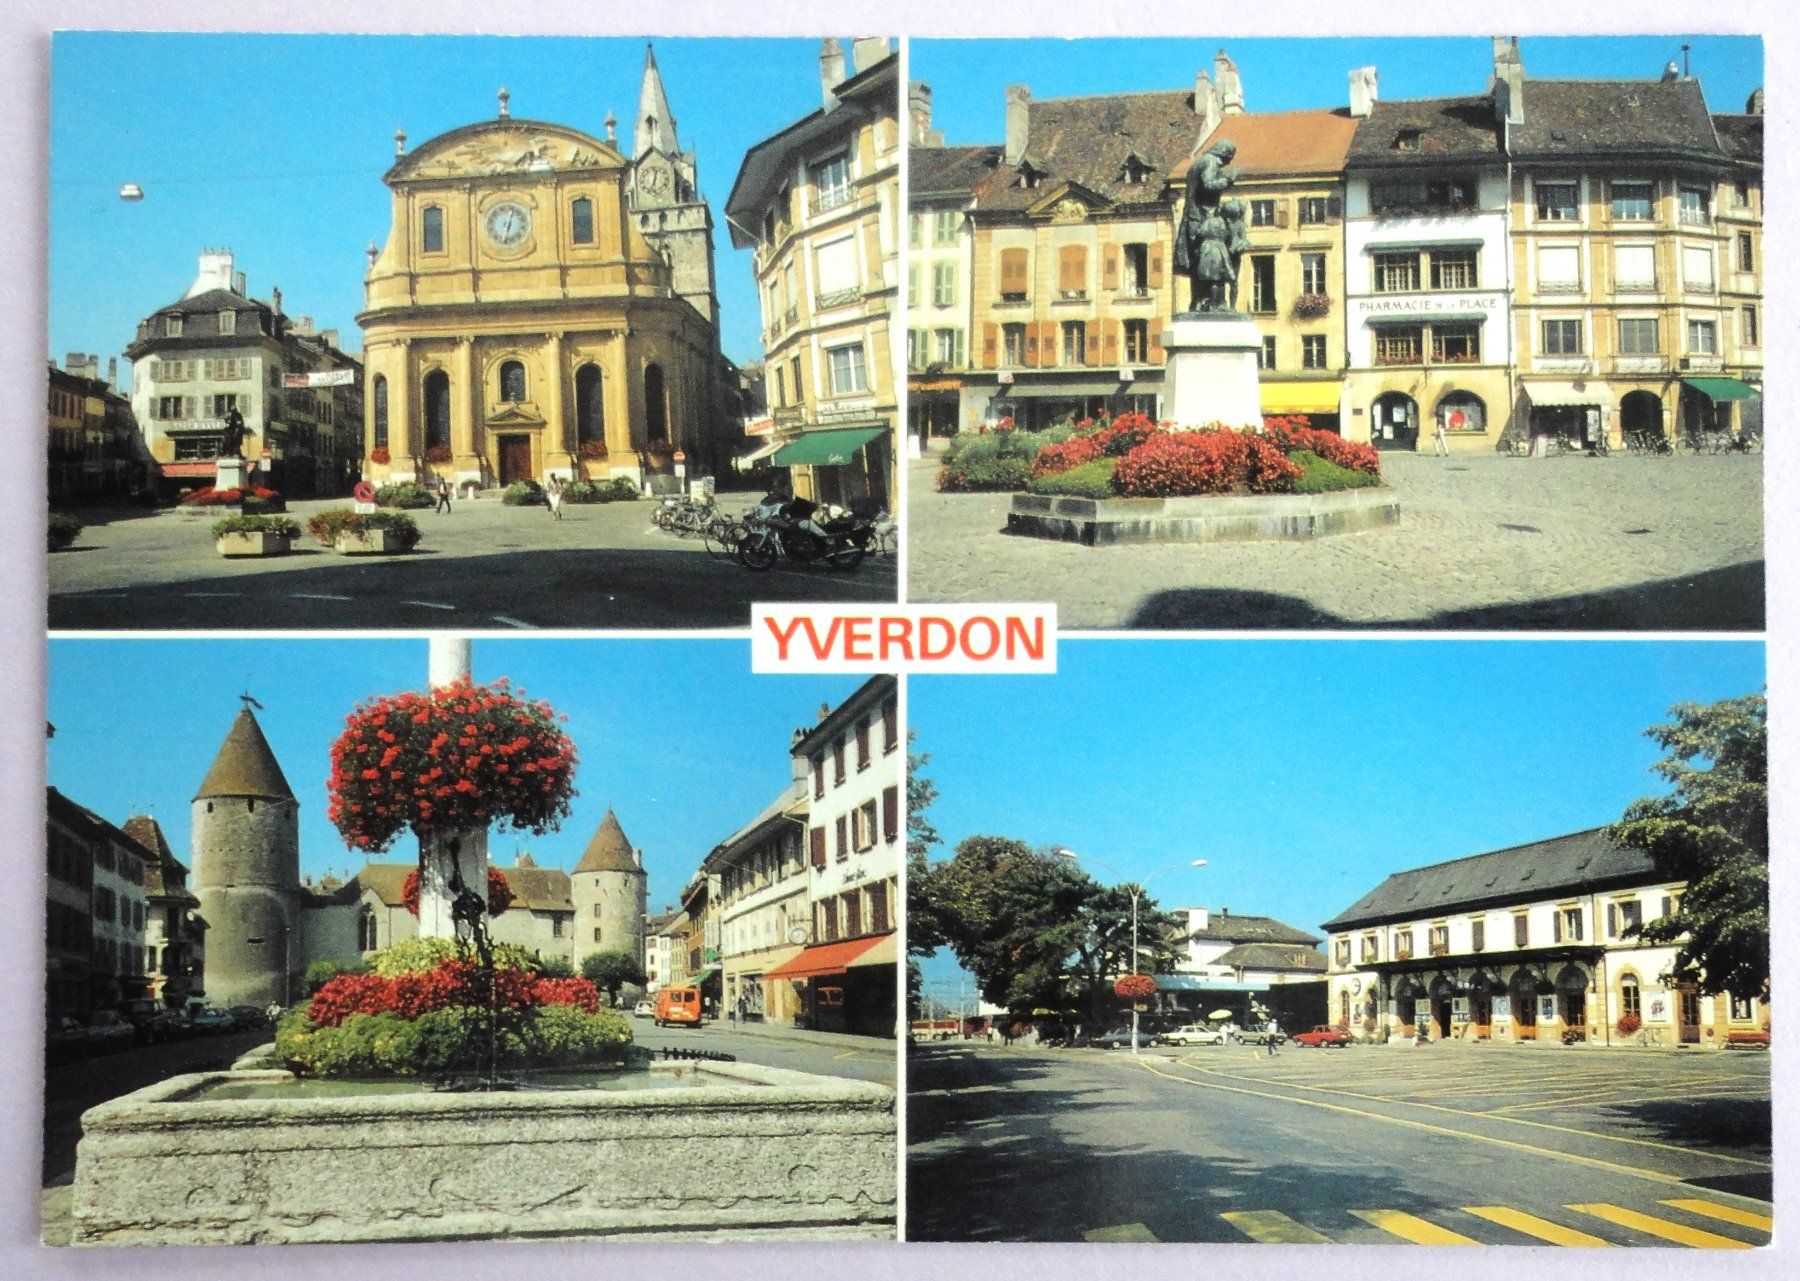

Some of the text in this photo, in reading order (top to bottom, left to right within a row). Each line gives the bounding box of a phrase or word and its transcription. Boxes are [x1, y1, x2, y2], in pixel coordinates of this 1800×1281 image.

[1359, 300, 1431, 312] PHARMACIE
[1459, 298, 1497, 309] PLACE
[763, 616, 1044, 661] YVERDON
